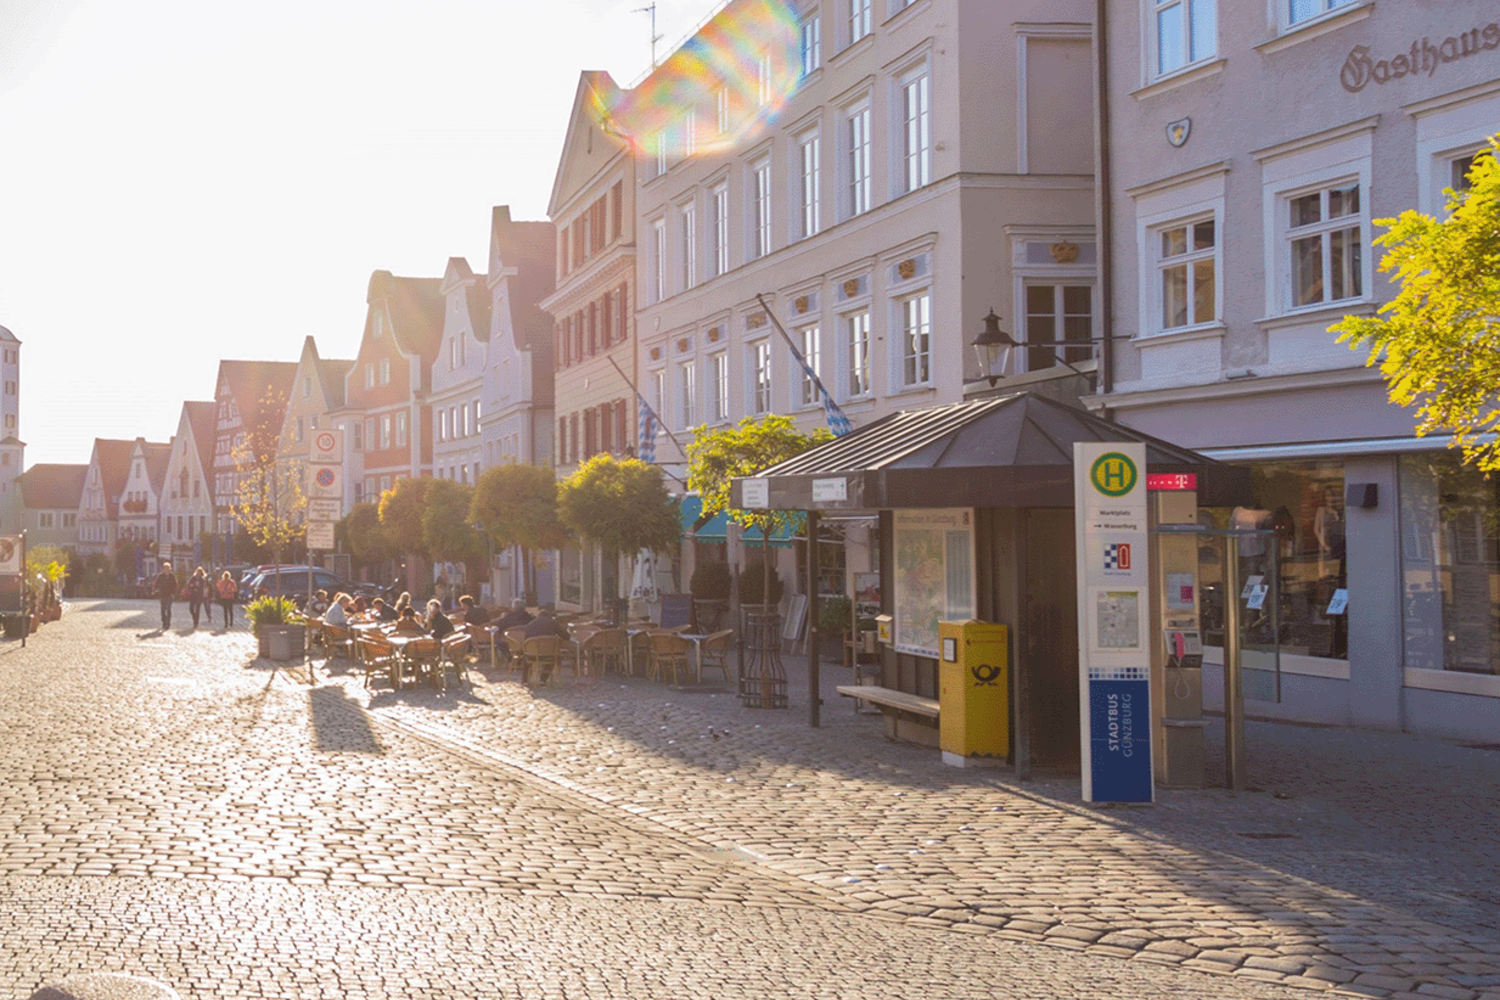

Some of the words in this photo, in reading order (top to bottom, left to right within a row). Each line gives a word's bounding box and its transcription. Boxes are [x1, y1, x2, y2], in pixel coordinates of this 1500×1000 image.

[1340, 23, 1500, 93] Gasthaus
[321, 437, 331, 446] 10
[1104, 461, 1124, 488] H
[1099, 510, 1131, 518] Marktplatz
[1103, 523, 1138, 531] Wasserburg
[1107, 693, 1119, 752] STADTBUS
[1121, 693, 1133, 758] GÜNZBURG
